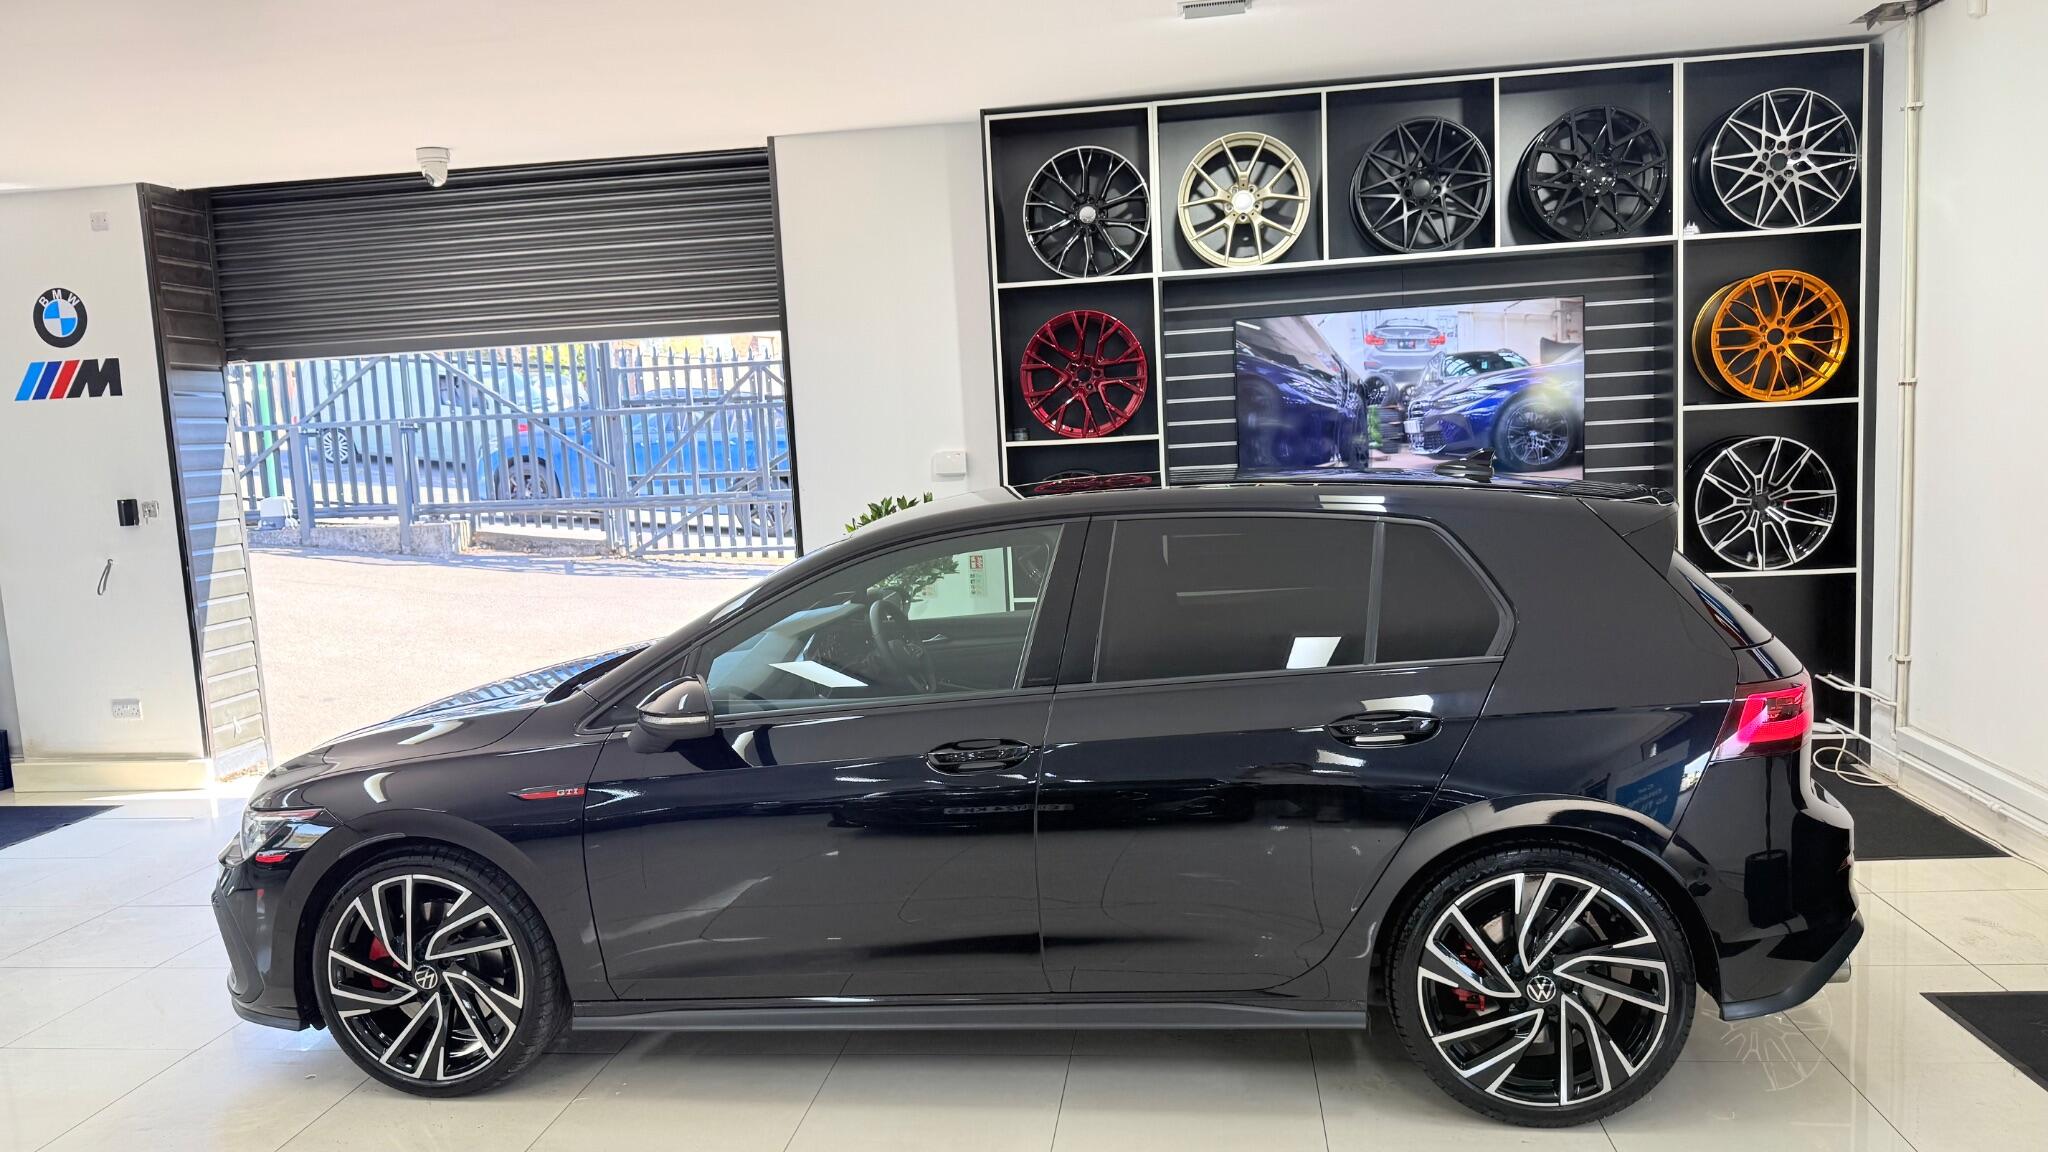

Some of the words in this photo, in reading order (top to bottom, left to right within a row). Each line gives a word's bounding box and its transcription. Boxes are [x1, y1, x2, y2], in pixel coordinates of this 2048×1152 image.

[38, 289, 81, 308] BMW
[556, 787, 580, 797] GTI
[1527, 975, 1556, 1003] VW
